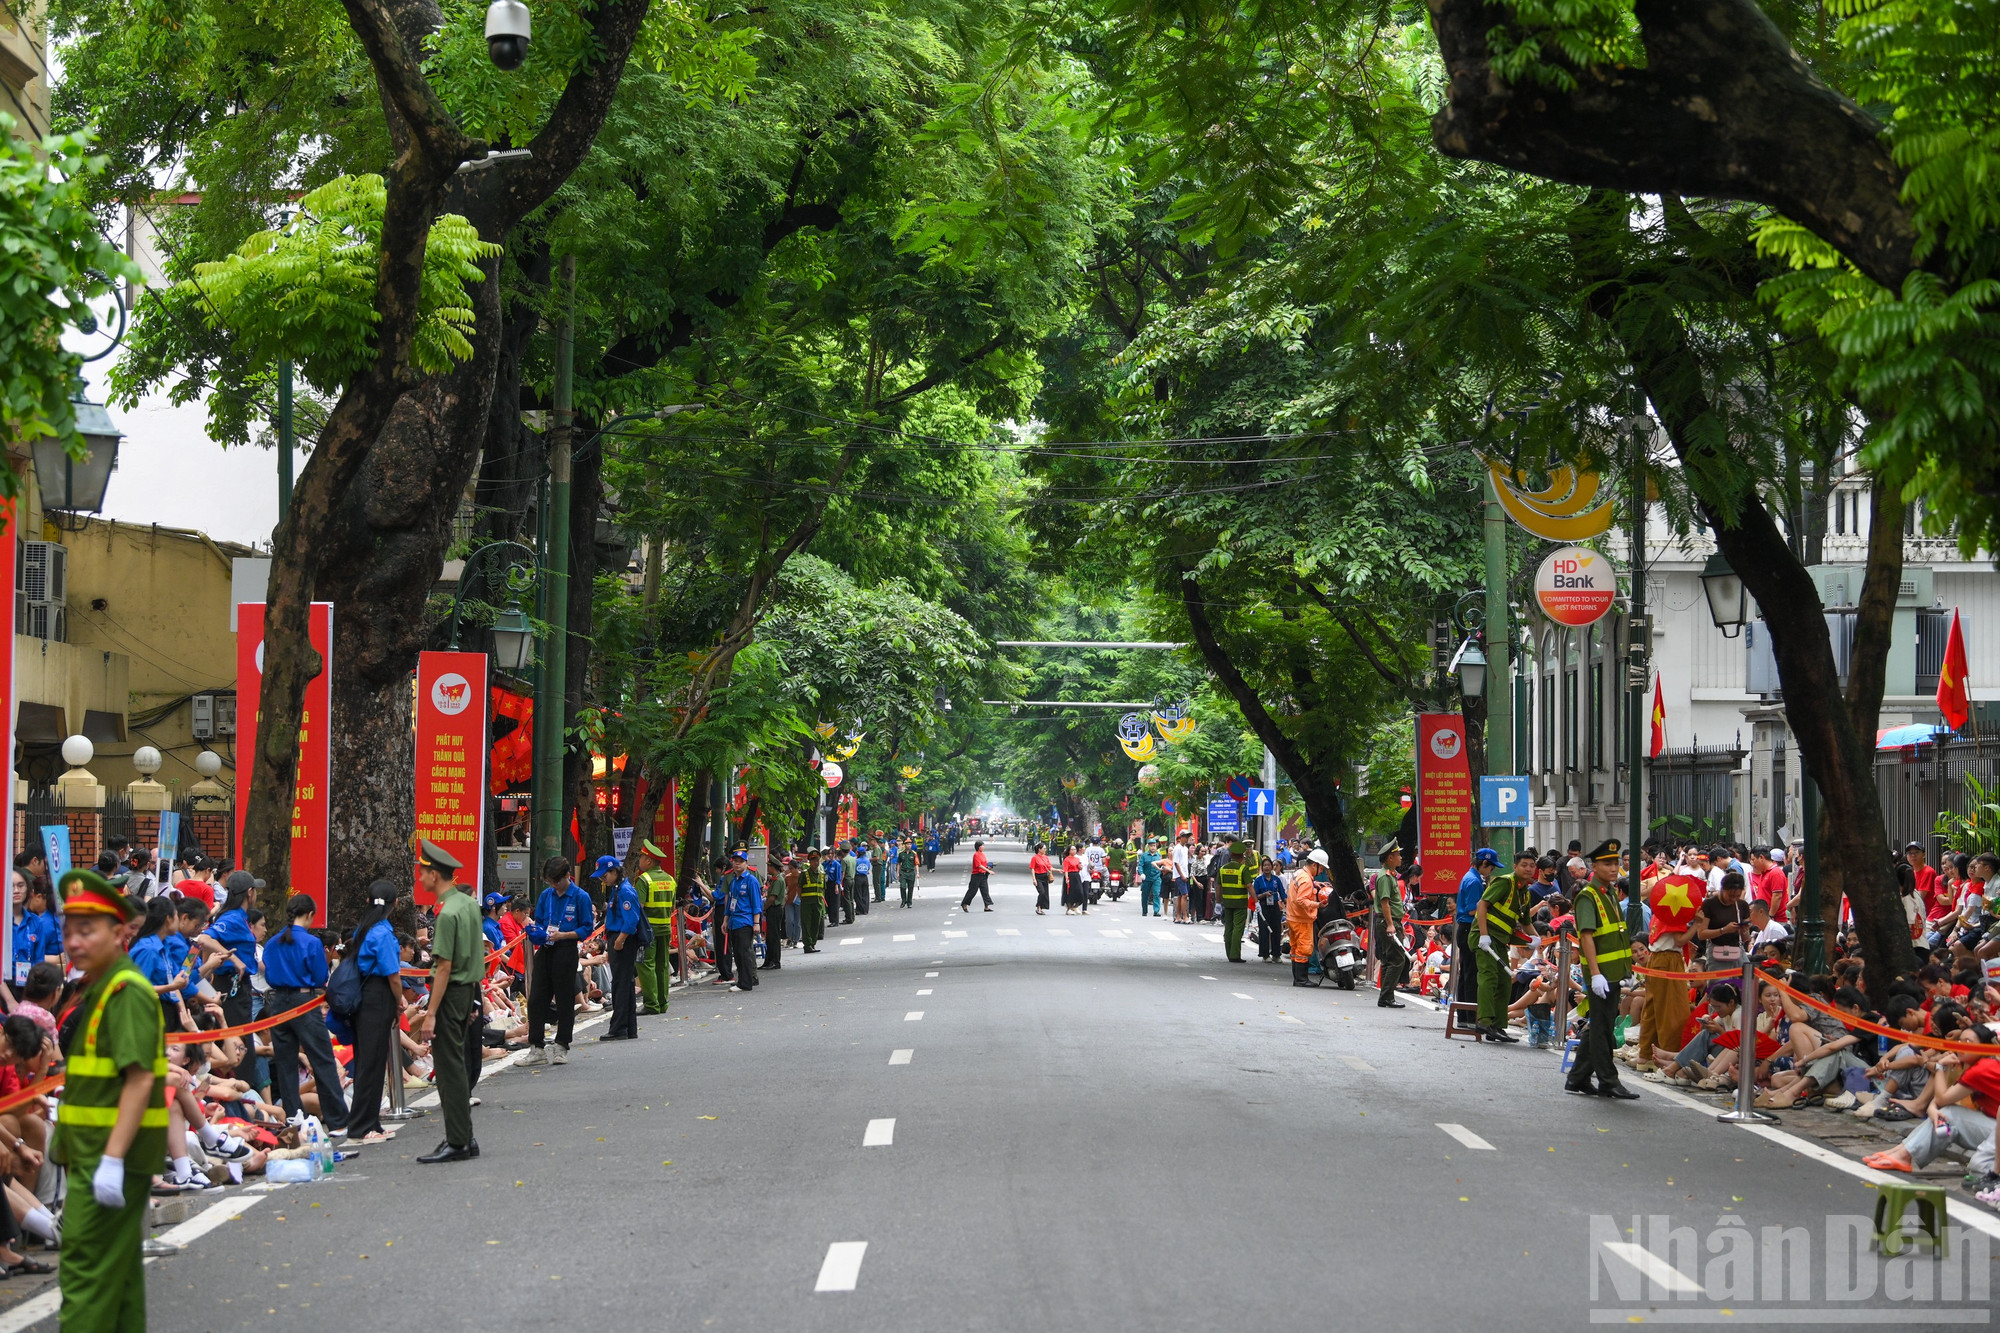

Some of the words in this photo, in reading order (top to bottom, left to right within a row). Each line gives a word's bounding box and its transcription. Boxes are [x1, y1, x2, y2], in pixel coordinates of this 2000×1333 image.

[1554, 560, 1577, 574] HD
[1554, 575, 1594, 588] Bank
[436, 733, 451, 746] PHÁT
[452, 735, 463, 746] HUY
[433, 749, 452, 762] THÀNH
[453, 748, 465, 762] QUẢ
[432, 764, 447, 777] CÁCH
[448, 766, 466, 780] MẠNG
[302, 784, 315, 800] SỬ
[431, 780, 449, 793] THÁNG
[450, 781, 465, 795] TÁM,
[435, 796, 447, 809] TIẾP
[449, 798, 460, 811] TỤC
[1498, 788, 1517, 813] P
[419, 811, 434, 824] CÔNG
[436, 812, 450, 827] CUỘC
[452, 812, 461, 825] ĐỔI
[463, 812, 475, 826] MỚI
[303, 826, 307, 838] !
[416, 828, 431, 840] TOÀN
[432, 828, 445, 842] DIỆN
[446, 828, 458, 840] ĐẤT
[459, 828, 475, 841] NƯỚC
[1090, 854, 1100, 863] 69
